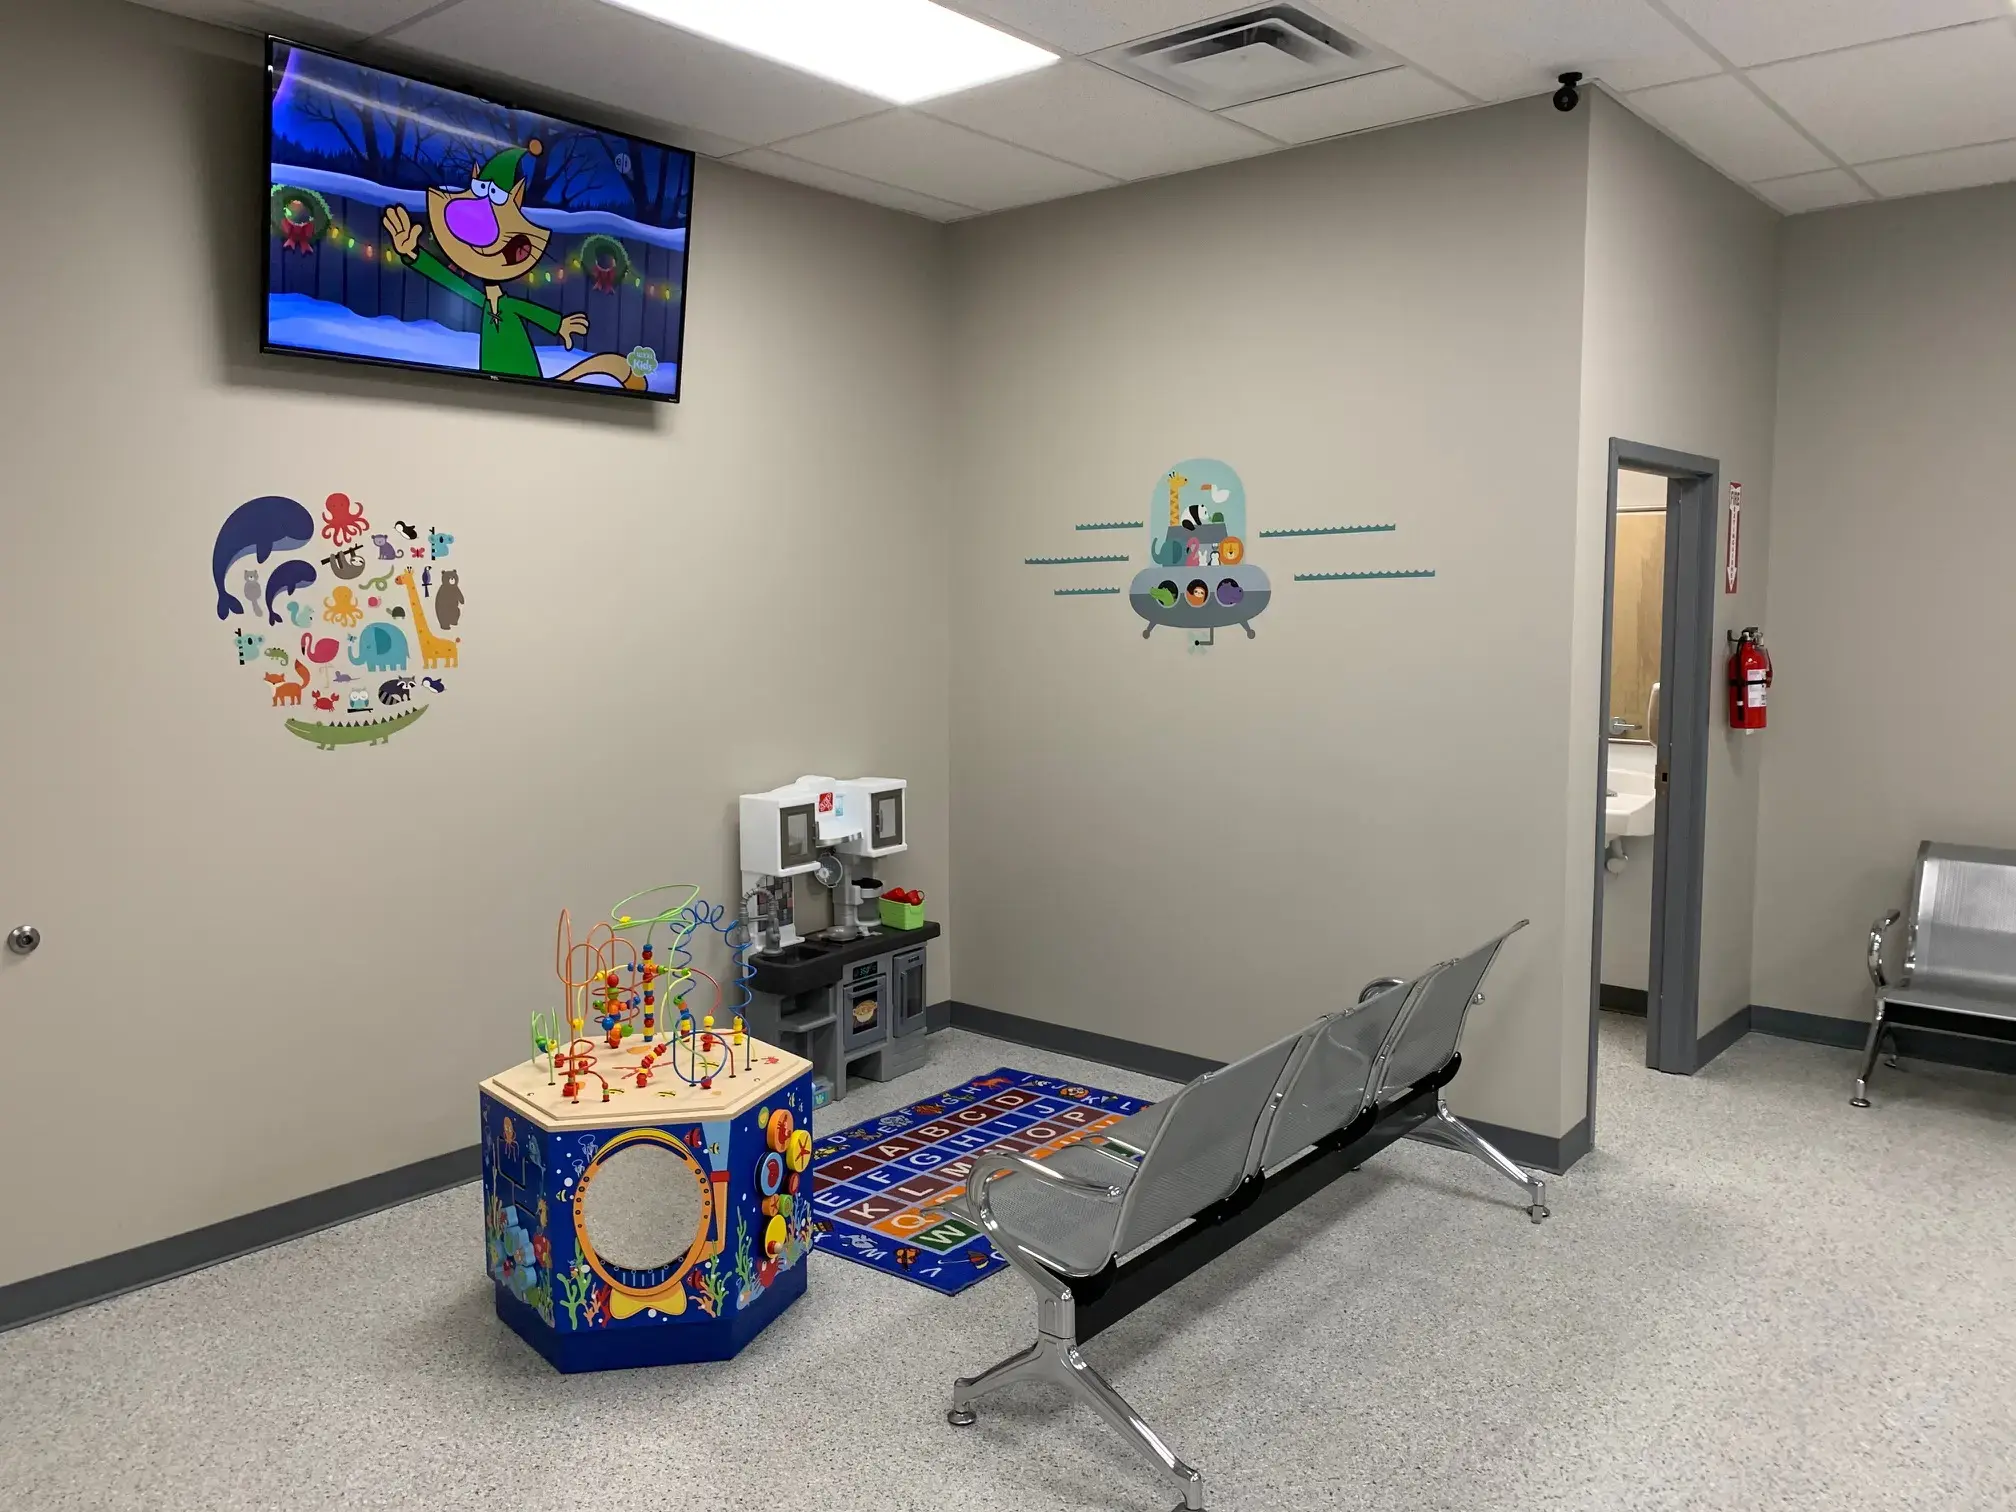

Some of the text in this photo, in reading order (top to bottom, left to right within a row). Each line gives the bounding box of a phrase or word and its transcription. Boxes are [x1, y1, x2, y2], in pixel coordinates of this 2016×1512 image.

[633, 359, 652, 371] Kids
[827, 1135, 847, 1143] D
[878, 1125, 898, 1134] E
[941, 1097, 959, 1105] G
[961, 1086, 981, 1095] H
[1080, 1095, 1100, 1104] K
[1120, 1101, 1131, 1111] L
[878, 1145, 910, 1157] A
[918, 1126, 950, 1138] B
[959, 1111, 987, 1121] C
[995, 1095, 1024, 1106] D
[814, 1192, 852, 1207] E
[867, 1170, 891, 1184] F
[909, 1153, 941, 1166] G
[950, 1134, 985, 1148] H
[1034, 1104, 1055, 1114] J
[849, 1111, 1086, 1219] K L M O P
[891, 1214, 936, 1229] Q
[919, 1224, 966, 1244] W
